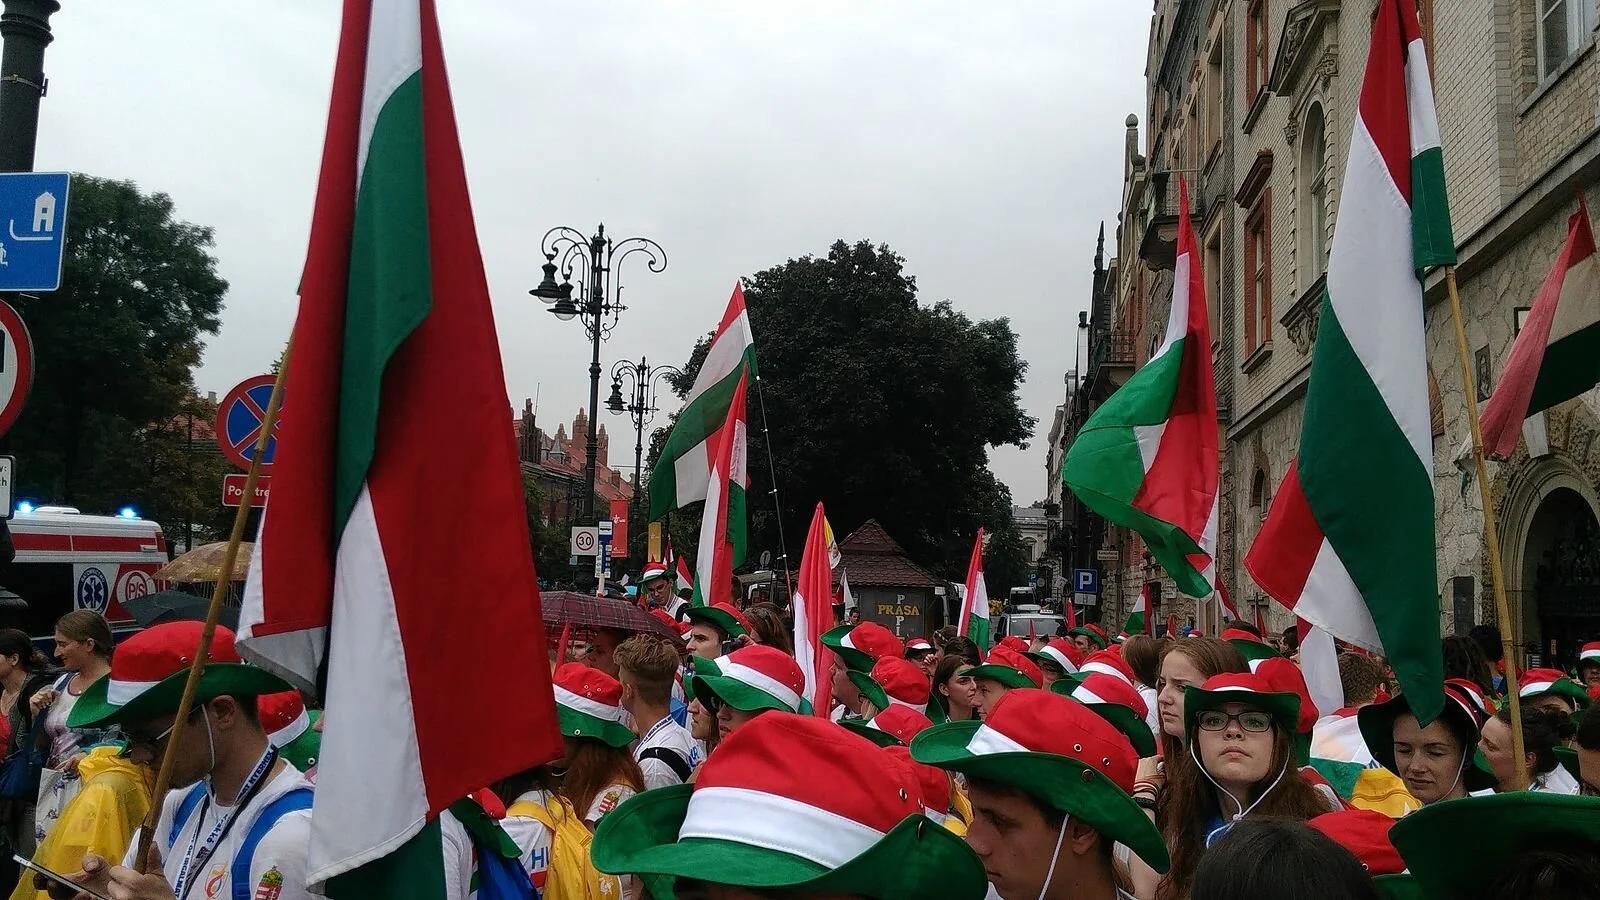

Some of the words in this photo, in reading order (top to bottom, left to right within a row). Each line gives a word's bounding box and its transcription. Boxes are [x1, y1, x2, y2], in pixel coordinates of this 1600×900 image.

[578, 536, 592, 546] 30
[1079, 571, 1093, 590] P
[877, 604, 920, 616] PRASA
